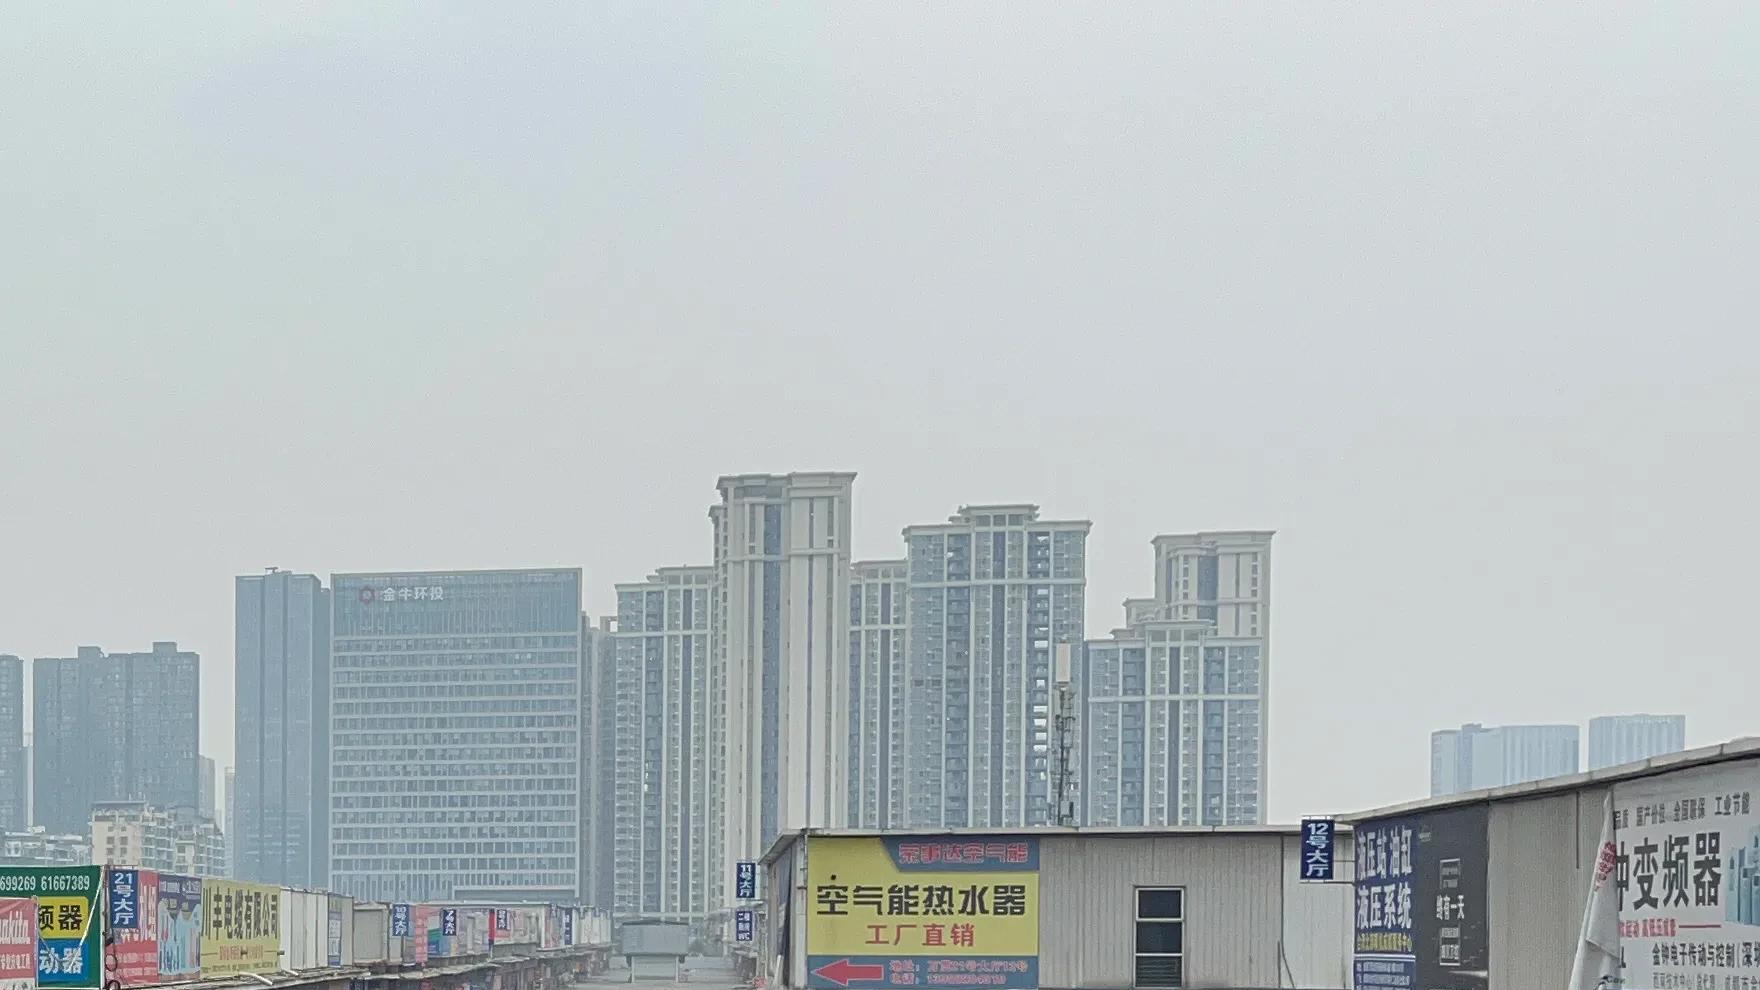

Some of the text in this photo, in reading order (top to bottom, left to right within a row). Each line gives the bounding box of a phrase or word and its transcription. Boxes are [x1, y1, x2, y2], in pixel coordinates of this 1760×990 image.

[382, 586, 444, 602] 金牛环投
[1307, 823, 1329, 877] 12号大厅
[40, 875, 90, 891] 61667389
[113, 872, 135, 925] 21号大厅
[817, 883, 1026, 916] 空气能热水器
[1356, 882, 1412, 930] 液压系统
[865, 923, 975, 947] 工厂直销
